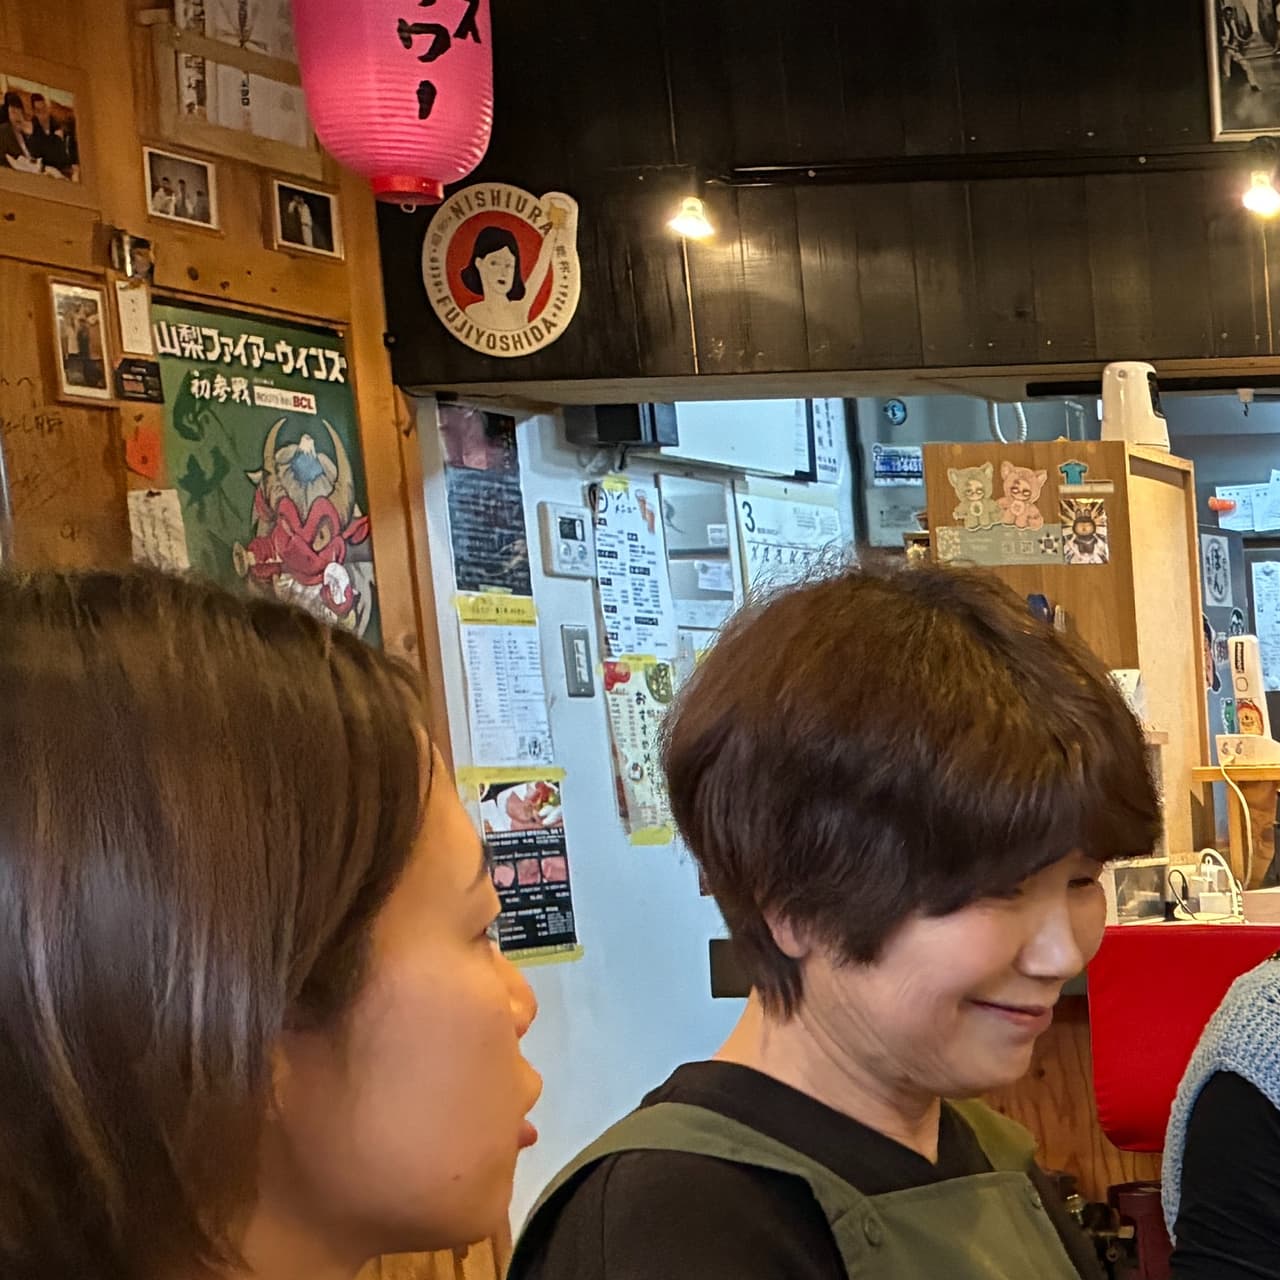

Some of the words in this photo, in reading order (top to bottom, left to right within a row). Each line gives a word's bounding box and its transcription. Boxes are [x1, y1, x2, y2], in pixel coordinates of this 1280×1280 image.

[450, 189, 553, 237] NISHIURA
[436, 295, 557, 352] FUJIYOSHIDA
[292, 395, 314, 411] BCL
[742, 501, 756, 533] 3
